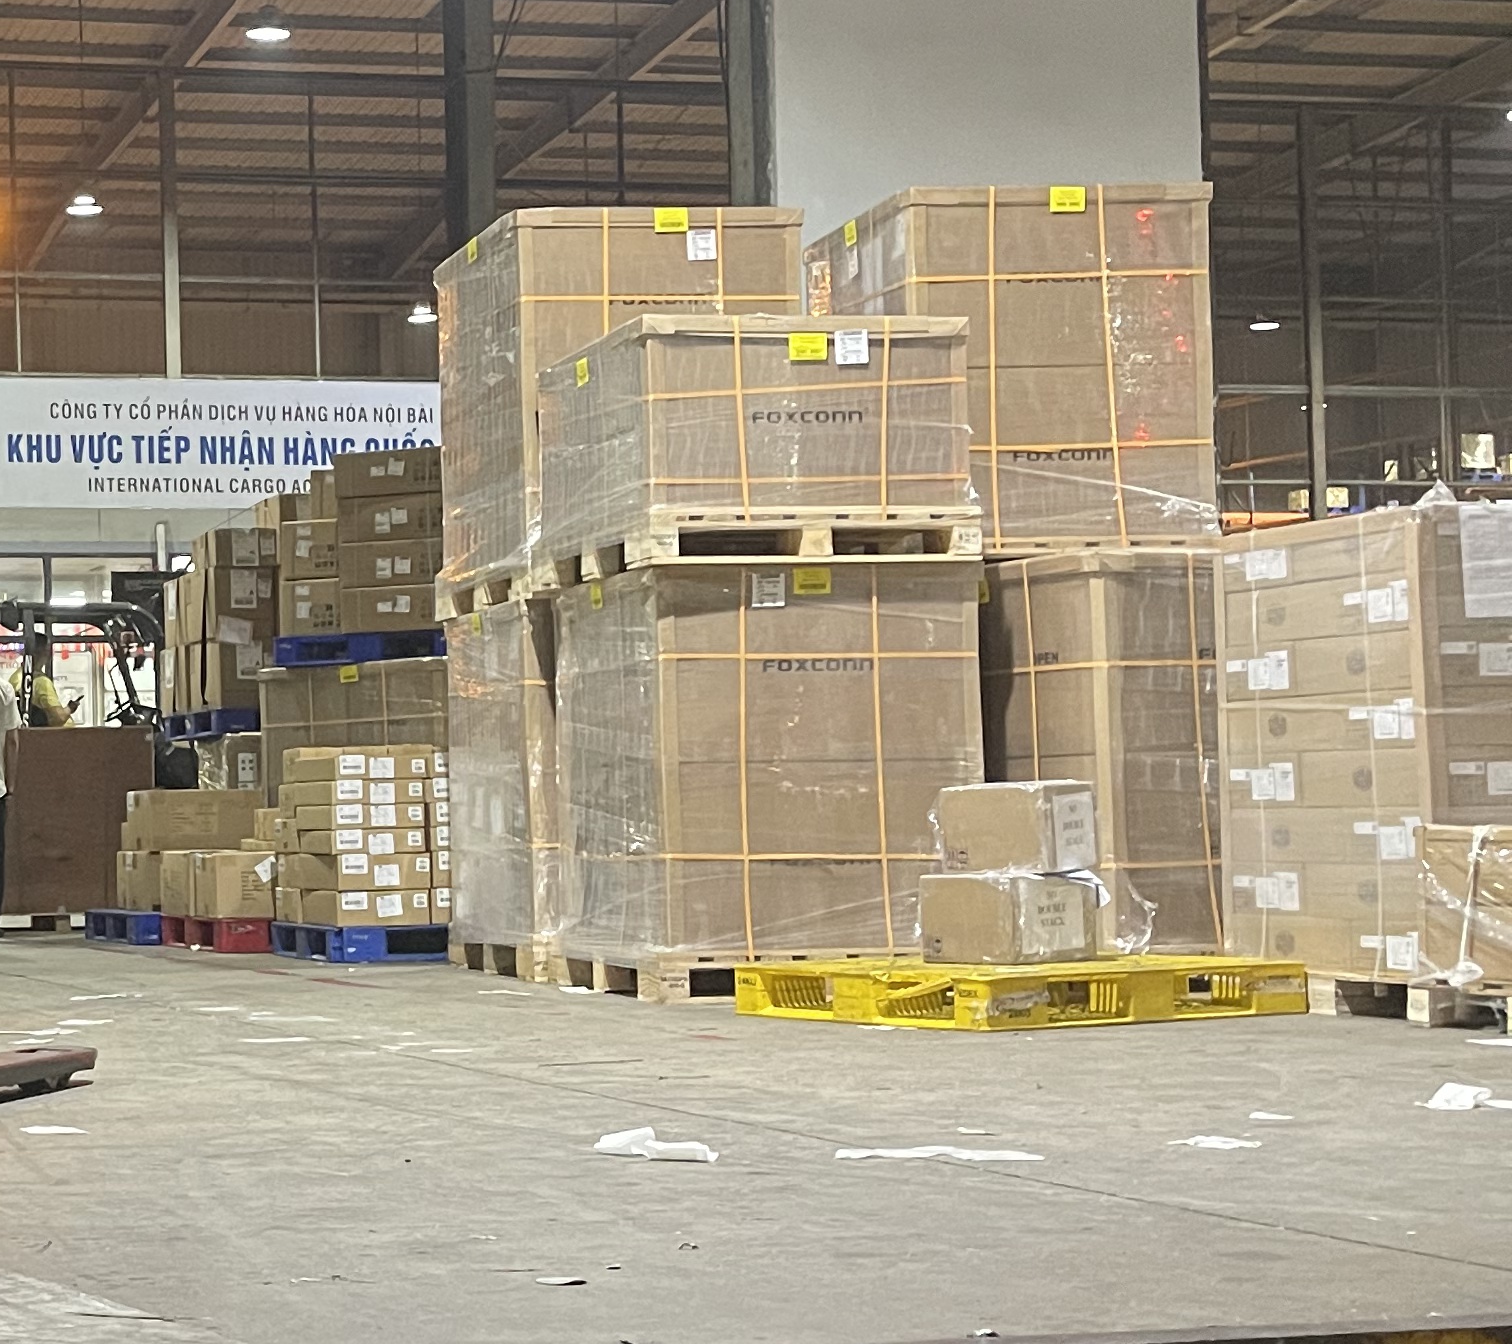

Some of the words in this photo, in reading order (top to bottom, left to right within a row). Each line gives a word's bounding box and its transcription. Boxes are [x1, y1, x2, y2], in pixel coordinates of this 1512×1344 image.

[50, 399, 97, 419] CÔNG
[103, 403, 123, 420] TY
[208, 404, 248, 425] DỊCH
[254, 405, 276, 425] VỤ
[282, 402, 328, 422] HÀNG
[373, 403, 401, 427] NỘI
[407, 403, 434, 424] BÀI
[752, 410, 863, 424] FOXCONN
[7, 433, 62, 464] KHU
[70, 431, 123, 470] VỰC
[131, 425, 191, 465] TIẾP
[200, 429, 275, 472] NHẬN
[88, 477, 224, 494] INTERNATIONAL
[229, 478, 286, 494] CARGO
[763, 659, 873, 672] FOXCONN
[22, 655, 33, 728] NCTS
